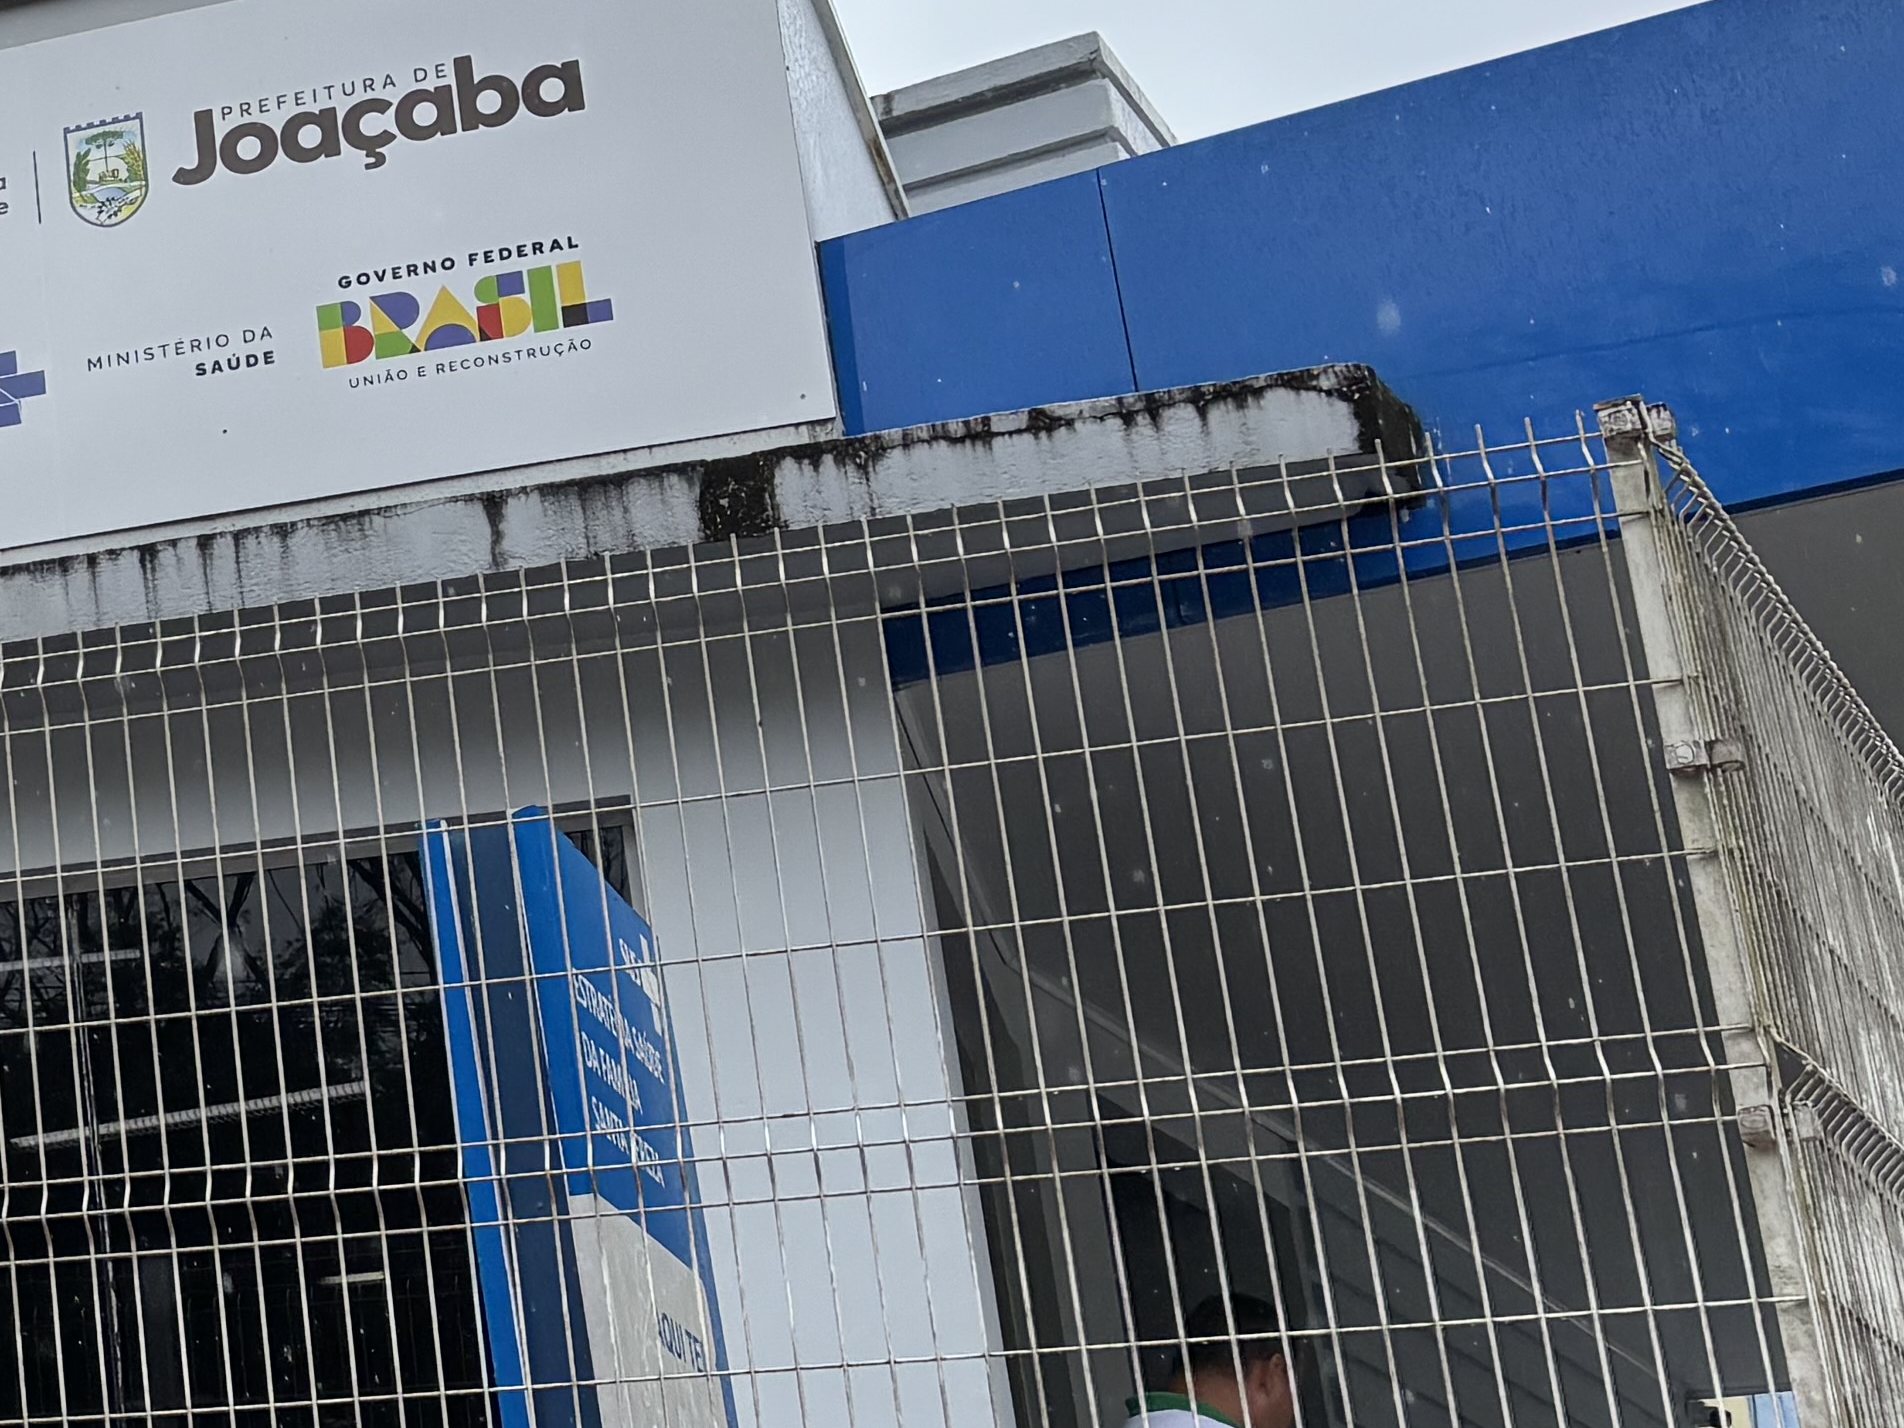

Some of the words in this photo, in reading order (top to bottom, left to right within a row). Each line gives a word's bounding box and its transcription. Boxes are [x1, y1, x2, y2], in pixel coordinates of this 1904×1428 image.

[220, 72, 397, 122] PREFEITURA
[413, 62, 449, 83] DE
[171, 54, 587, 186] Joaçaba
[337, 256, 456, 289] GOVERNO
[467, 235, 580, 267] FEDERAL
[316, 260, 614, 369] BRASIL
[86, 332, 230, 373] MINISTÉRIO
[242, 326, 274, 345] DA
[194, 349, 276, 377] SAÚDE
[348, 368, 409, 389] UNIÃO
[417, 365, 428, 378] E
[435, 338, 593, 376] RECONSTRUÇÃO
